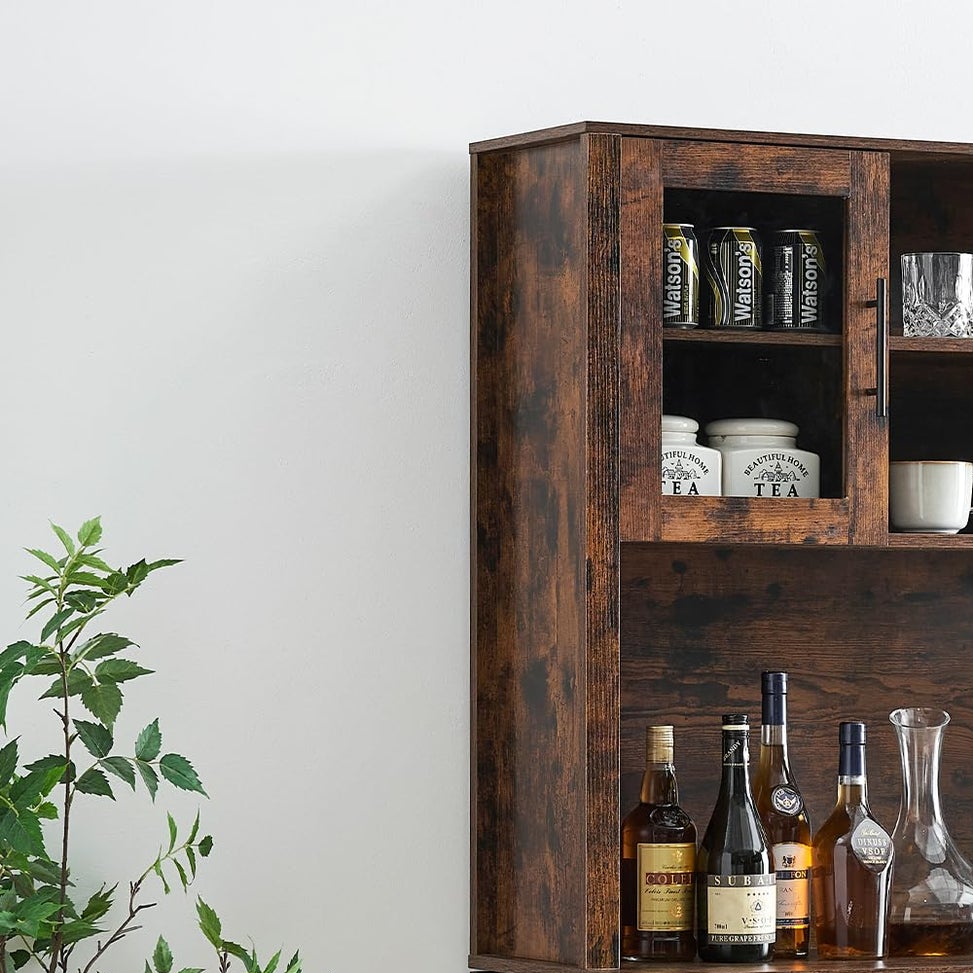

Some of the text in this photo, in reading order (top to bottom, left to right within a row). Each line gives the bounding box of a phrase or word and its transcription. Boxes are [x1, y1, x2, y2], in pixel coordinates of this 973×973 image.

[664, 239, 682, 318] Watson's
[734, 242, 752, 321] Watson's
[801, 245, 818, 324] Watson's
[688, 453, 710, 475] HOME
[743, 453, 809, 478] BEAUTIFUL HOME
[753, 483, 800, 497] TEA
